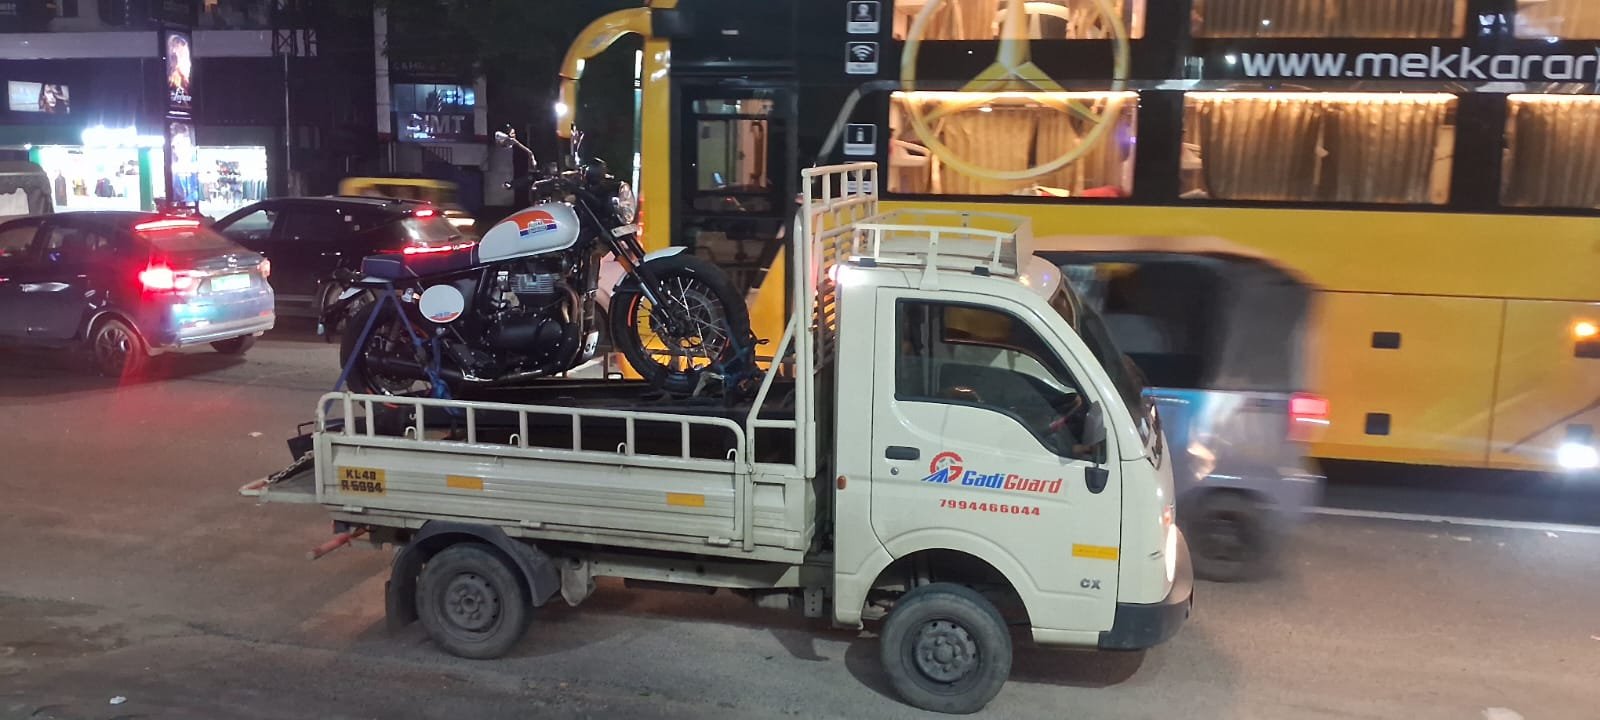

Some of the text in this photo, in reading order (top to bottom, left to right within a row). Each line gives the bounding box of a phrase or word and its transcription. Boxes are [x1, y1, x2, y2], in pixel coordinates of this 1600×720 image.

[962, 471, 1062, 493] GadiGuard
[939, 499, 1041, 516] 7994466044
[1079, 577, 1101, 590] CX
